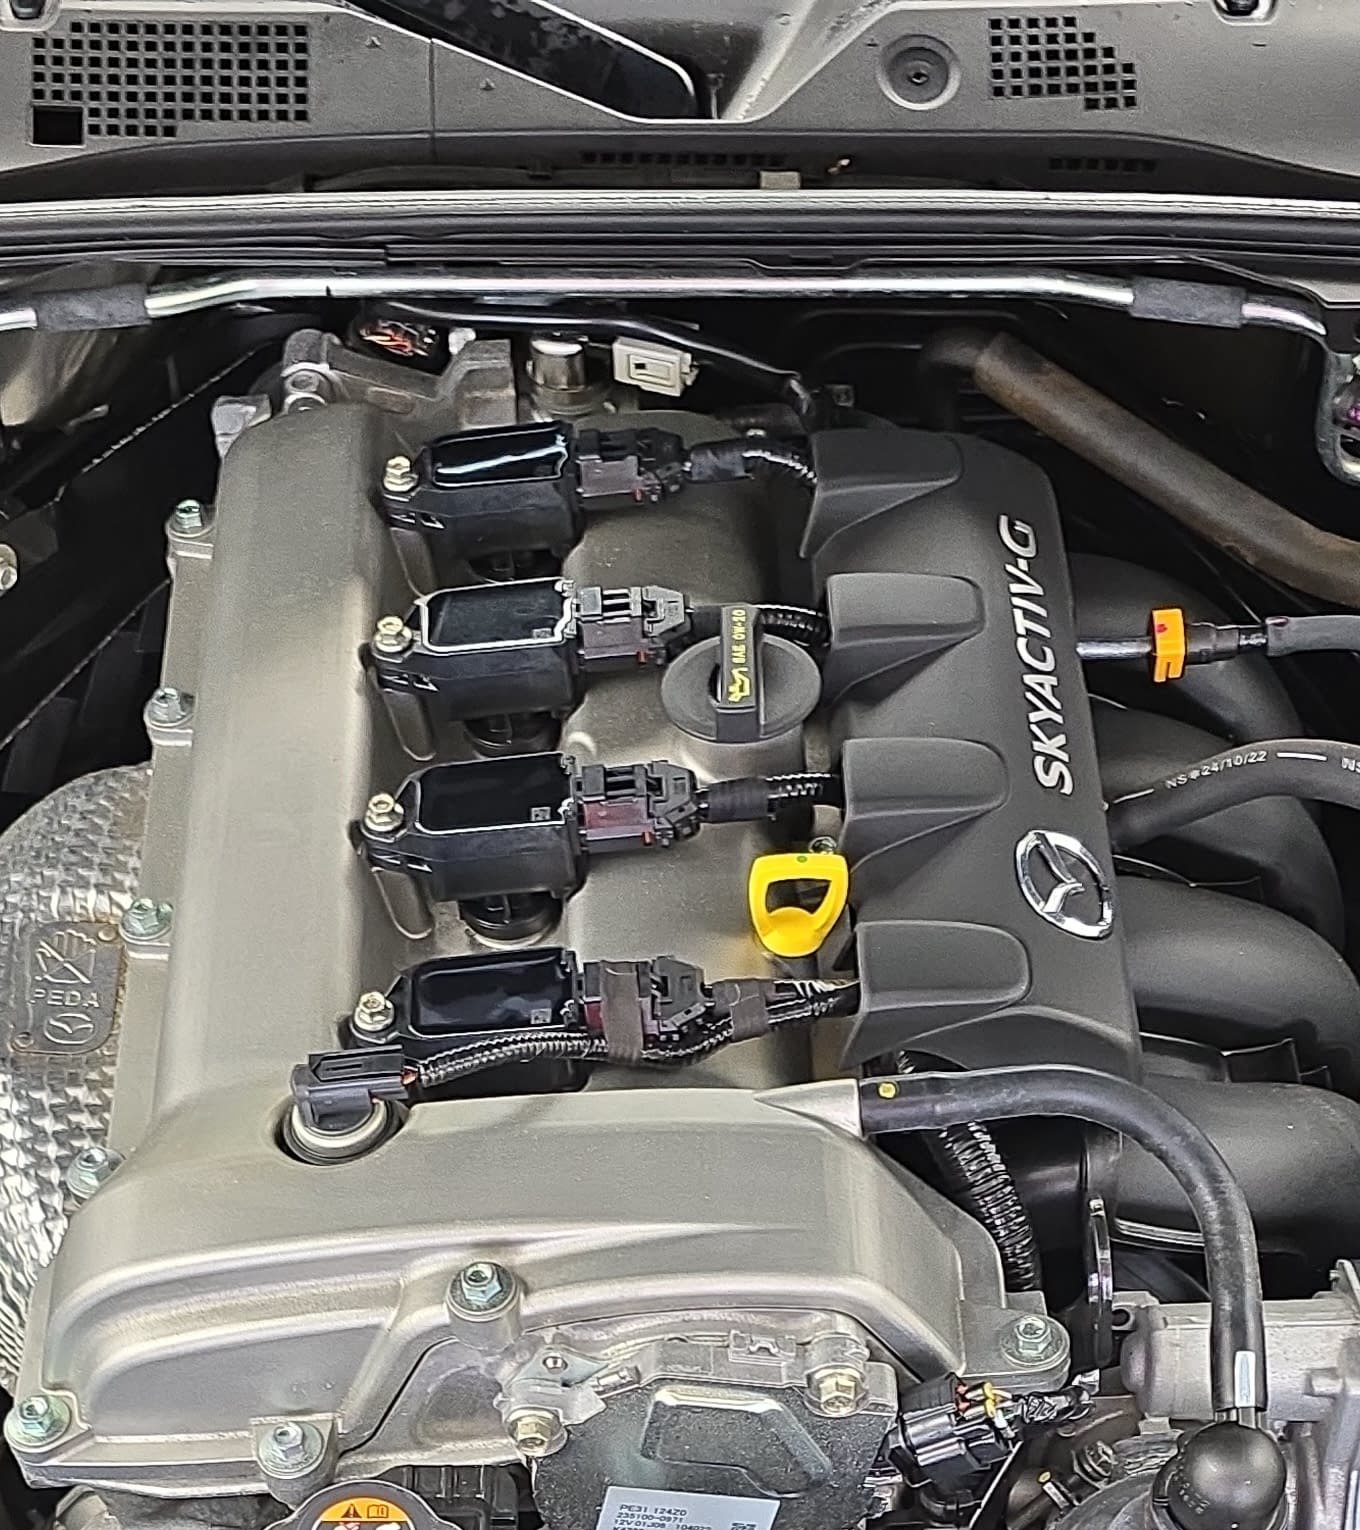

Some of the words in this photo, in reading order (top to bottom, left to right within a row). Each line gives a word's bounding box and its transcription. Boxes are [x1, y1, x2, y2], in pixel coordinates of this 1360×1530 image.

[731, 609, 746, 641] 0W-20
[998, 513, 1074, 797] SKYACTIV-G
[30, 987, 101, 1008] PEDA
